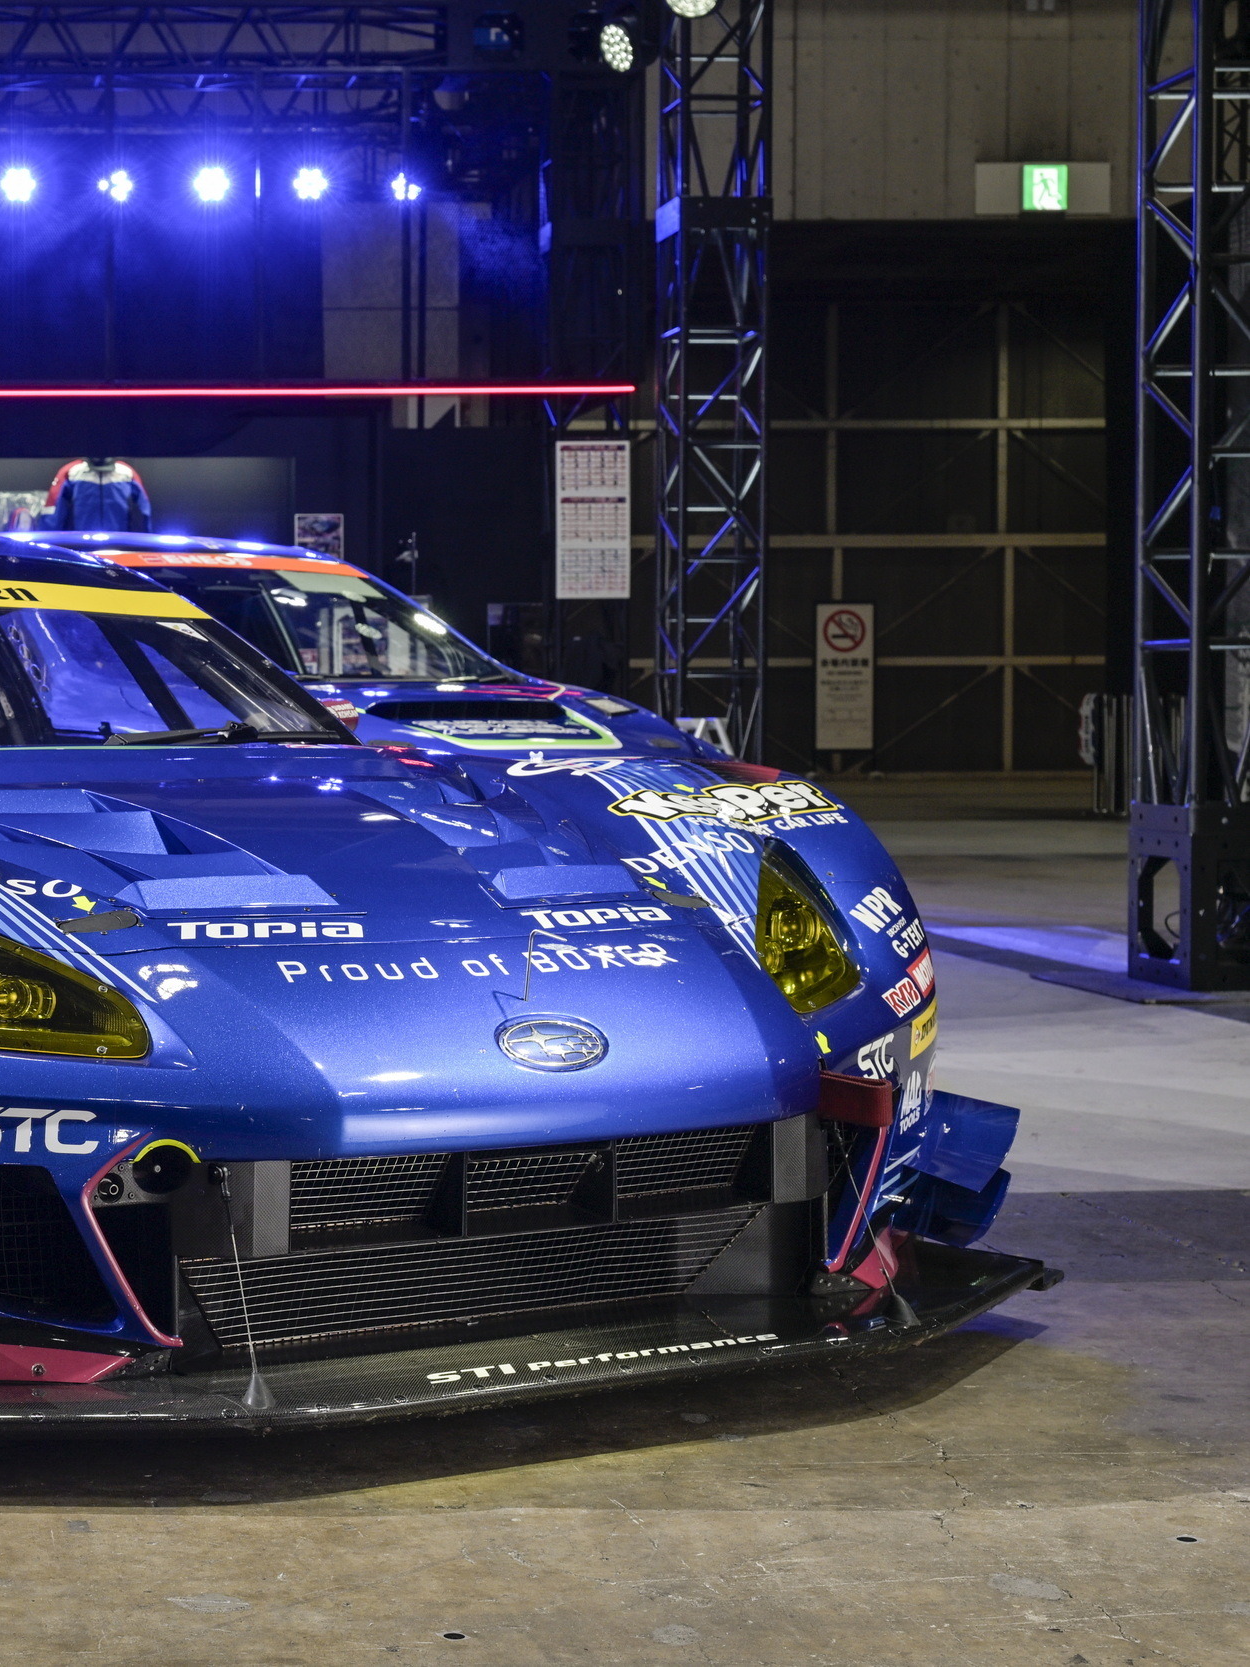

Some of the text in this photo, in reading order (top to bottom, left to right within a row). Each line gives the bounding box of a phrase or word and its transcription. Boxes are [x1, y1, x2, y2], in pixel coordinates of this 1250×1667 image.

[161, 554, 253, 566] ENEOS
[813, 812, 849, 826] LIFE
[620, 831, 755, 874] DENSO
[849, 886, 903, 933] NPR
[892, 917, 925, 959] G-TEKT
[276, 956, 439, 984] Proud
[461, 951, 510, 978] of
[900, 1107, 922, 1136] TOOLS
[426, 1362, 518, 1385] STI
